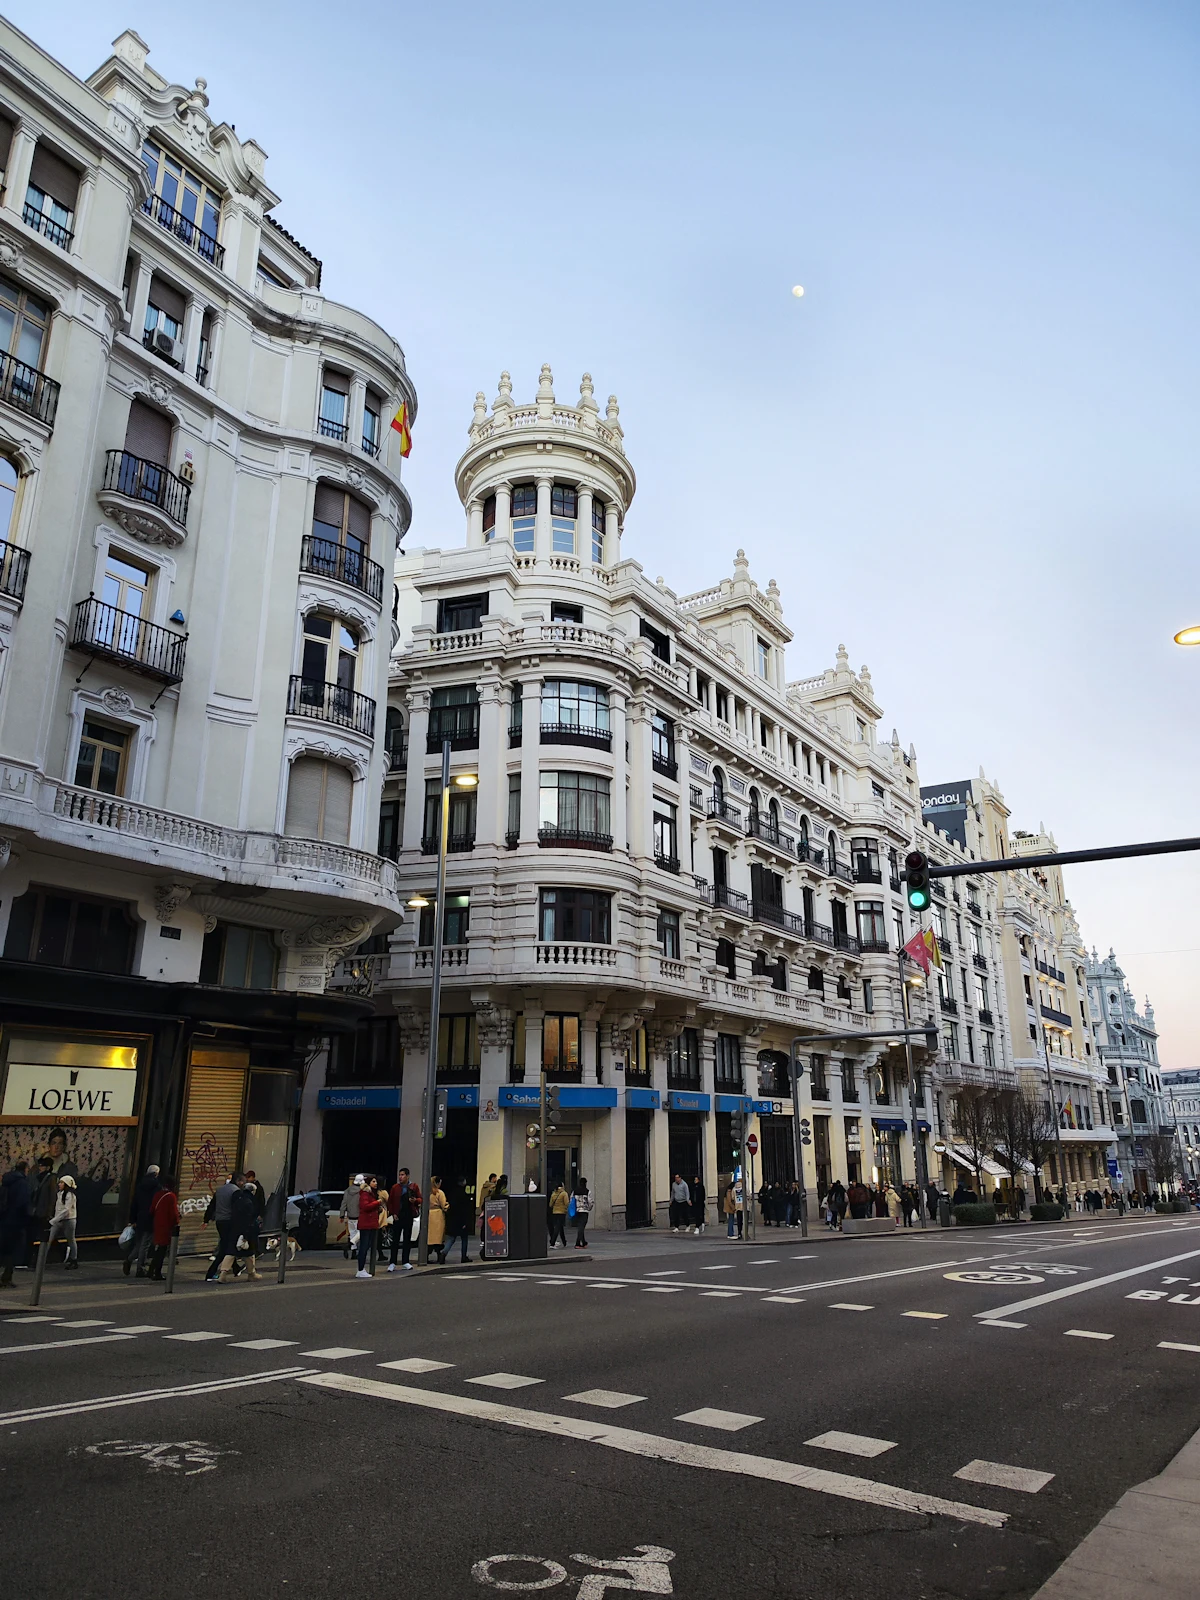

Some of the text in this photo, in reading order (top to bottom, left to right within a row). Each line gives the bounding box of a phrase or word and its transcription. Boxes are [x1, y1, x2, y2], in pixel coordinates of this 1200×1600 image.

[28, 1088, 113, 1111] LOEWE
[329, 1096, 367, 1106] Sabadell
[53, 1115, 83, 1125] LOEWE
[965, 1272, 1024, 1282] 30
